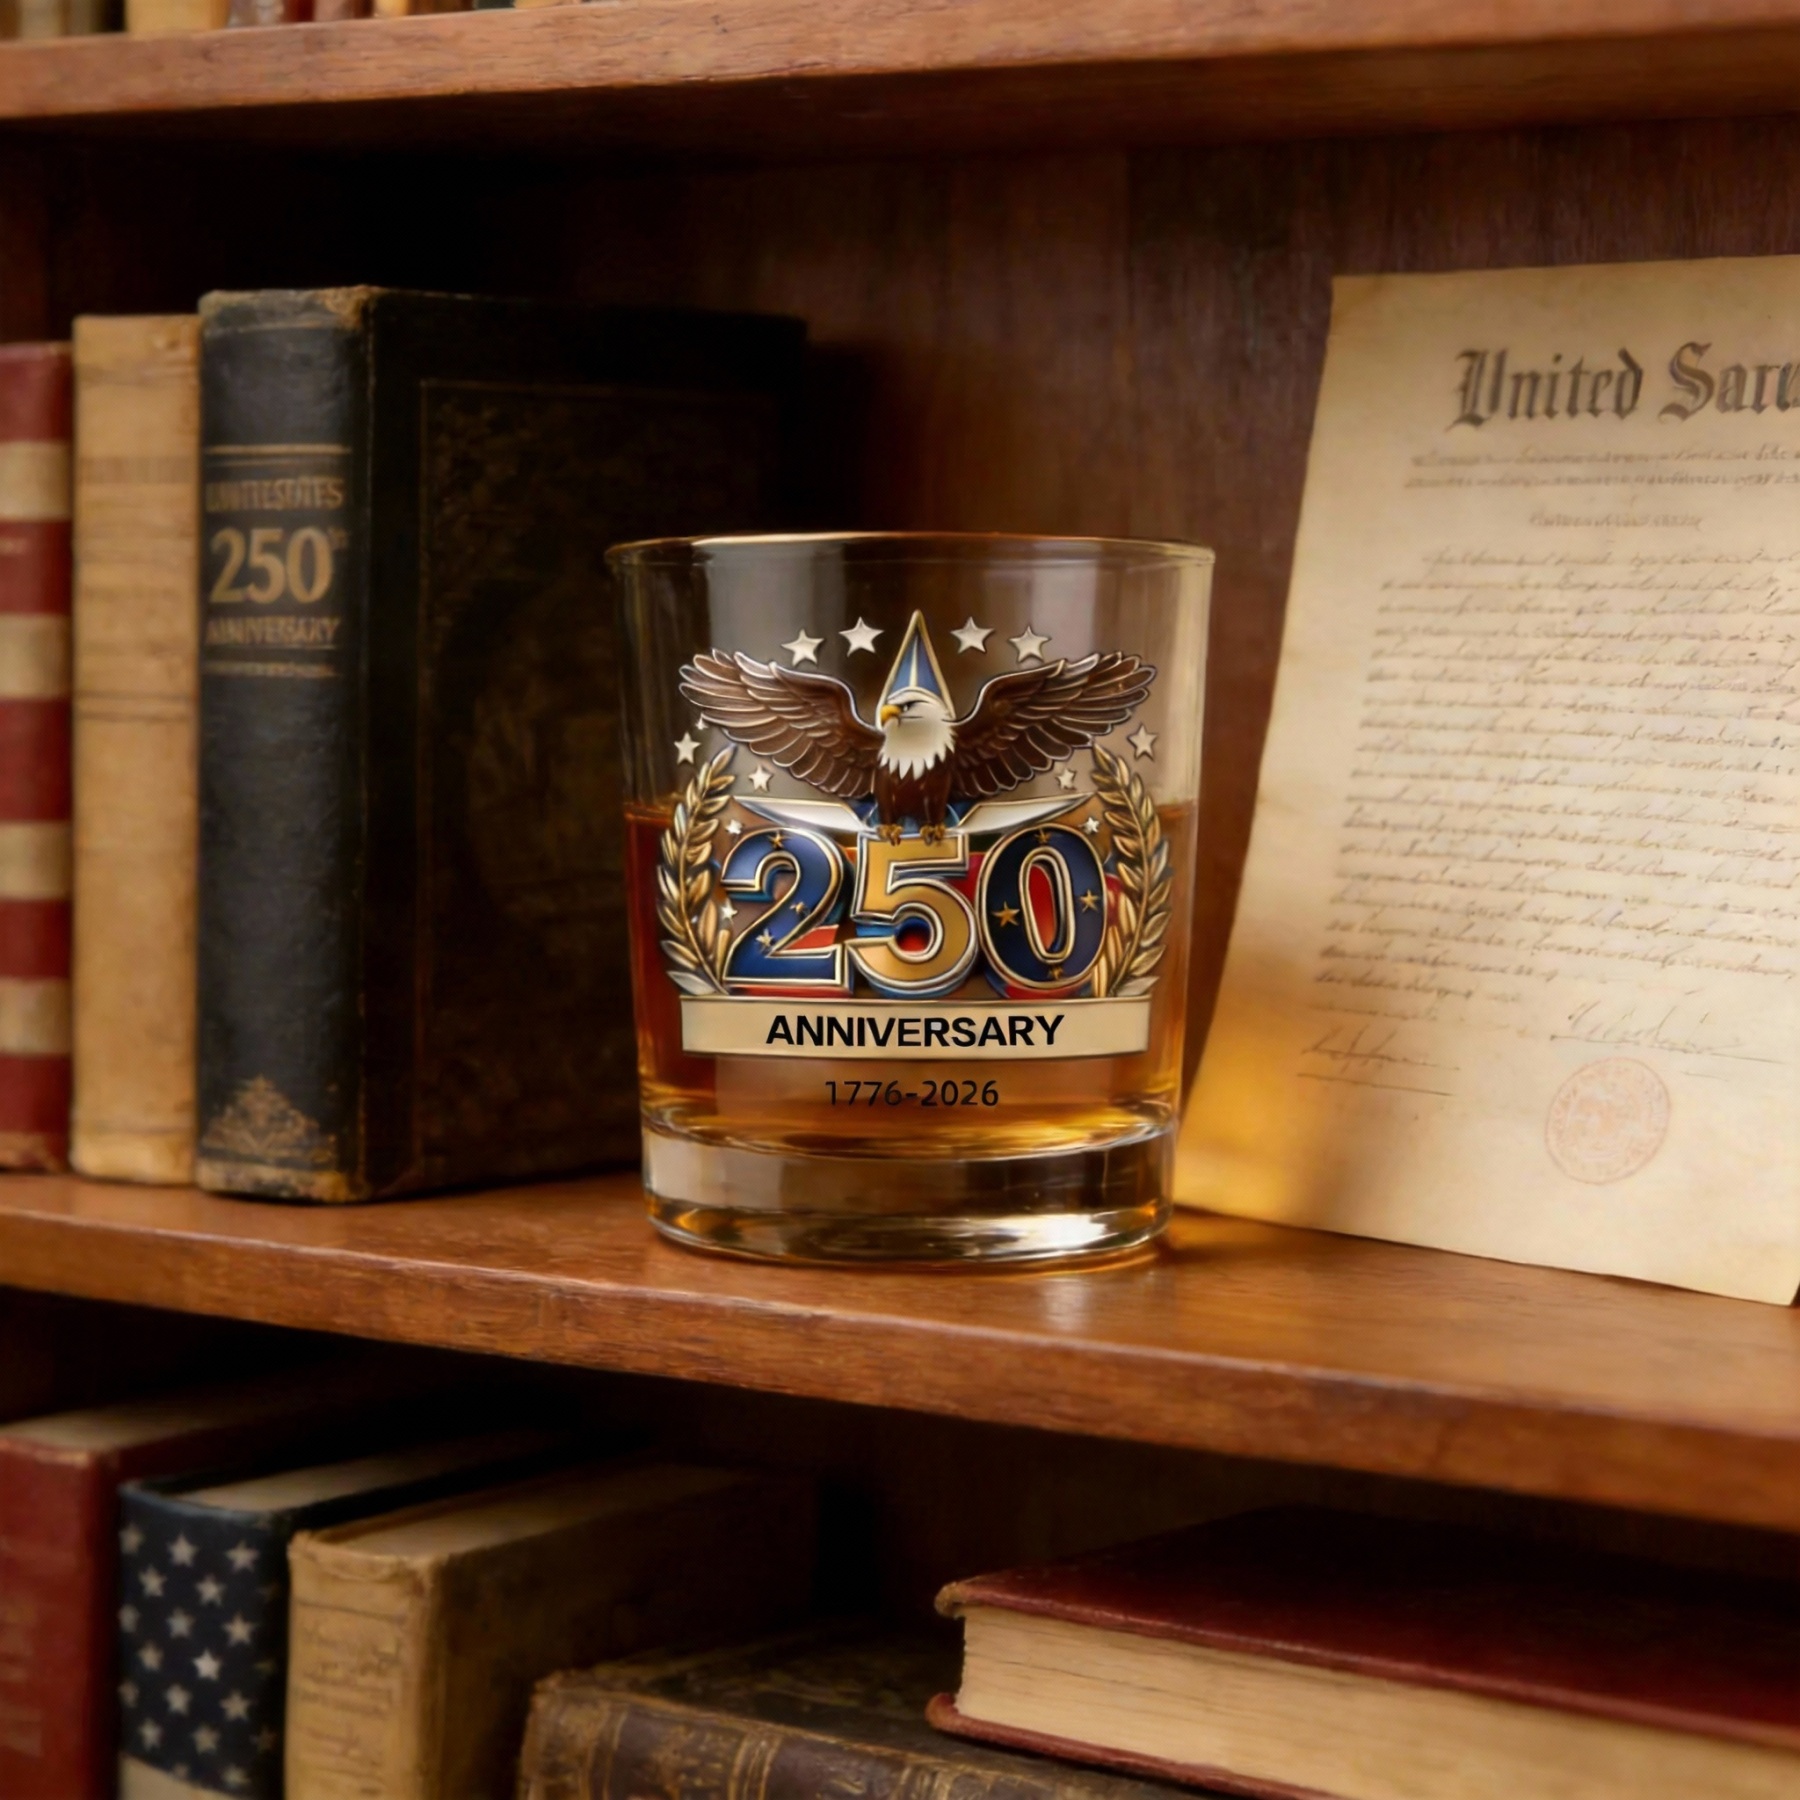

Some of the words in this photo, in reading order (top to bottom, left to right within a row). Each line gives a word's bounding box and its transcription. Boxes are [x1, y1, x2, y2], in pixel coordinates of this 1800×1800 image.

[1445, 348, 1643, 431] United
[721, 822, 1108, 998] 250
[765, 1014, 1065, 1047] ANNIVERSARY
[824, 1079, 999, 1107] 1776-2026
